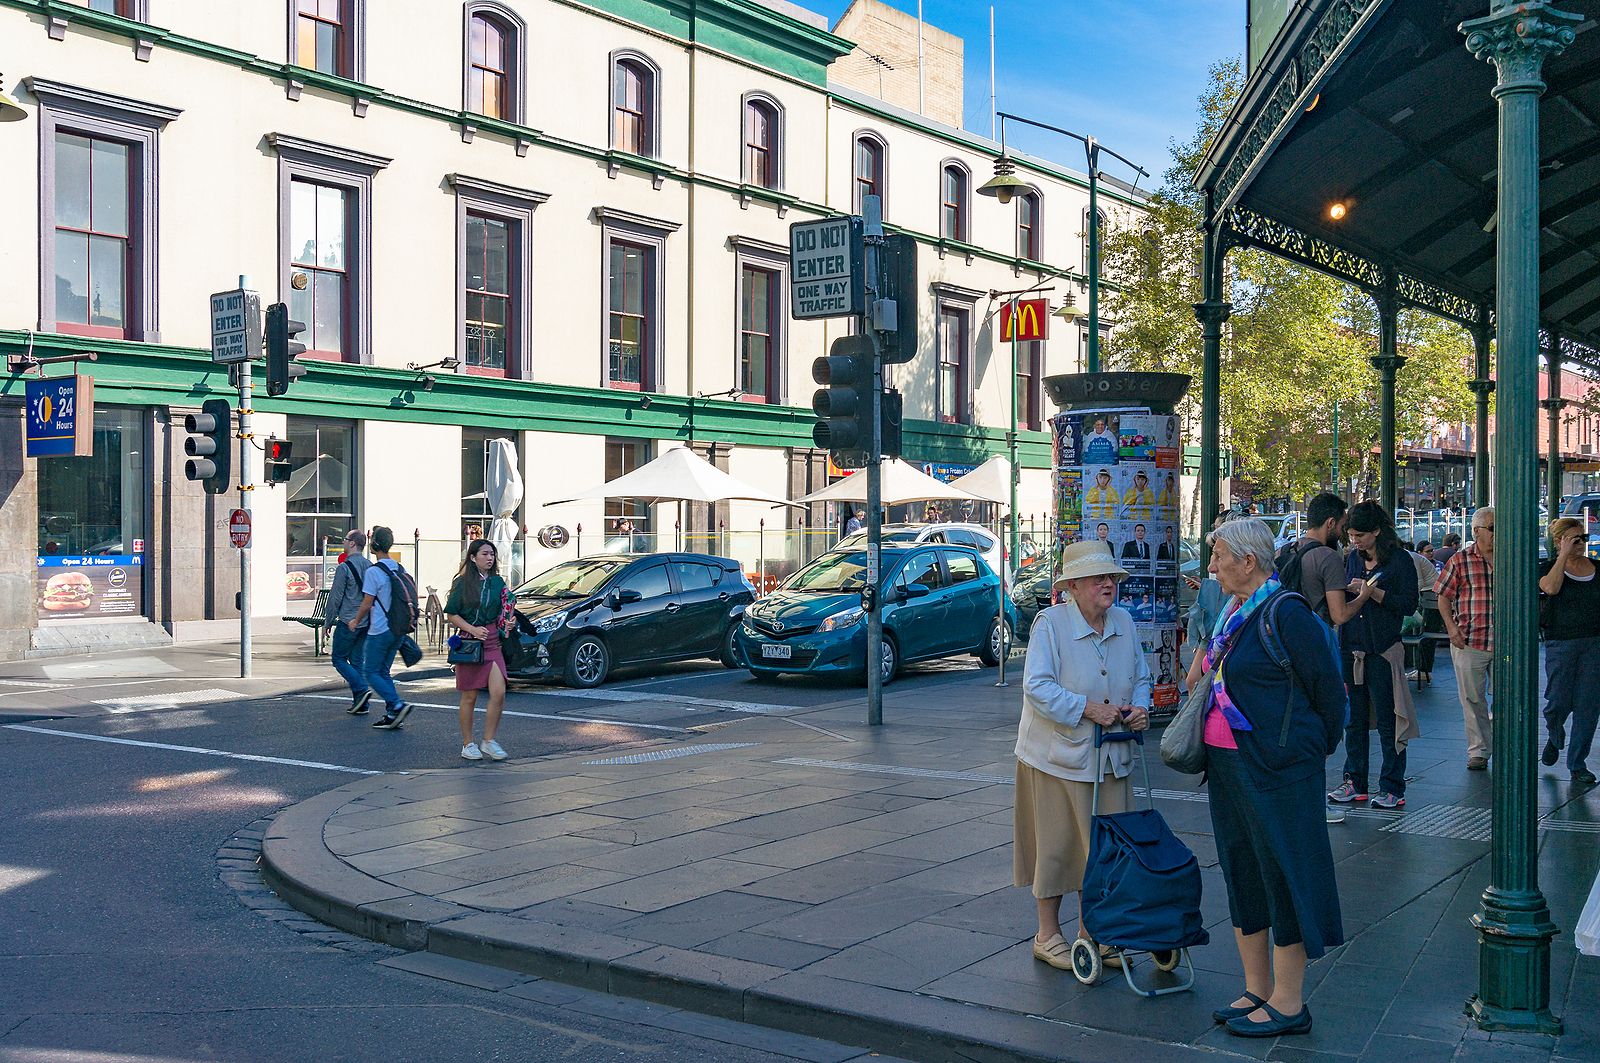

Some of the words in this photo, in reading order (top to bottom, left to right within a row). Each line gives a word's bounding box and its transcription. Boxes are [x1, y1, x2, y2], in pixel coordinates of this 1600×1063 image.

[796, 229, 816, 252] DO
[820, 225, 847, 249] NOT
[797, 255, 845, 278] ENTER
[798, 285, 820, 298] ONE
[824, 282, 848, 295] WAY
[213, 299, 224, 312] DO
[227, 295, 243, 311] NOT
[800, 297, 845, 312] TRAFFIC
[215, 315, 242, 331] ENTER
[215, 336, 228, 346] ONE
[230, 333, 243, 344] WAY
[217, 345, 243, 356] TRAFFIC
[58, 386, 74, 397] Open
[1083, 377, 1161, 396] poster
[58, 397, 74, 417] 24
[56, 420, 73, 430] Hours
[235, 515, 244, 523] NO
[232, 533, 249, 542] ENTRY
[61, 558, 81, 566] Open
[81, 557, 93, 565] 24
